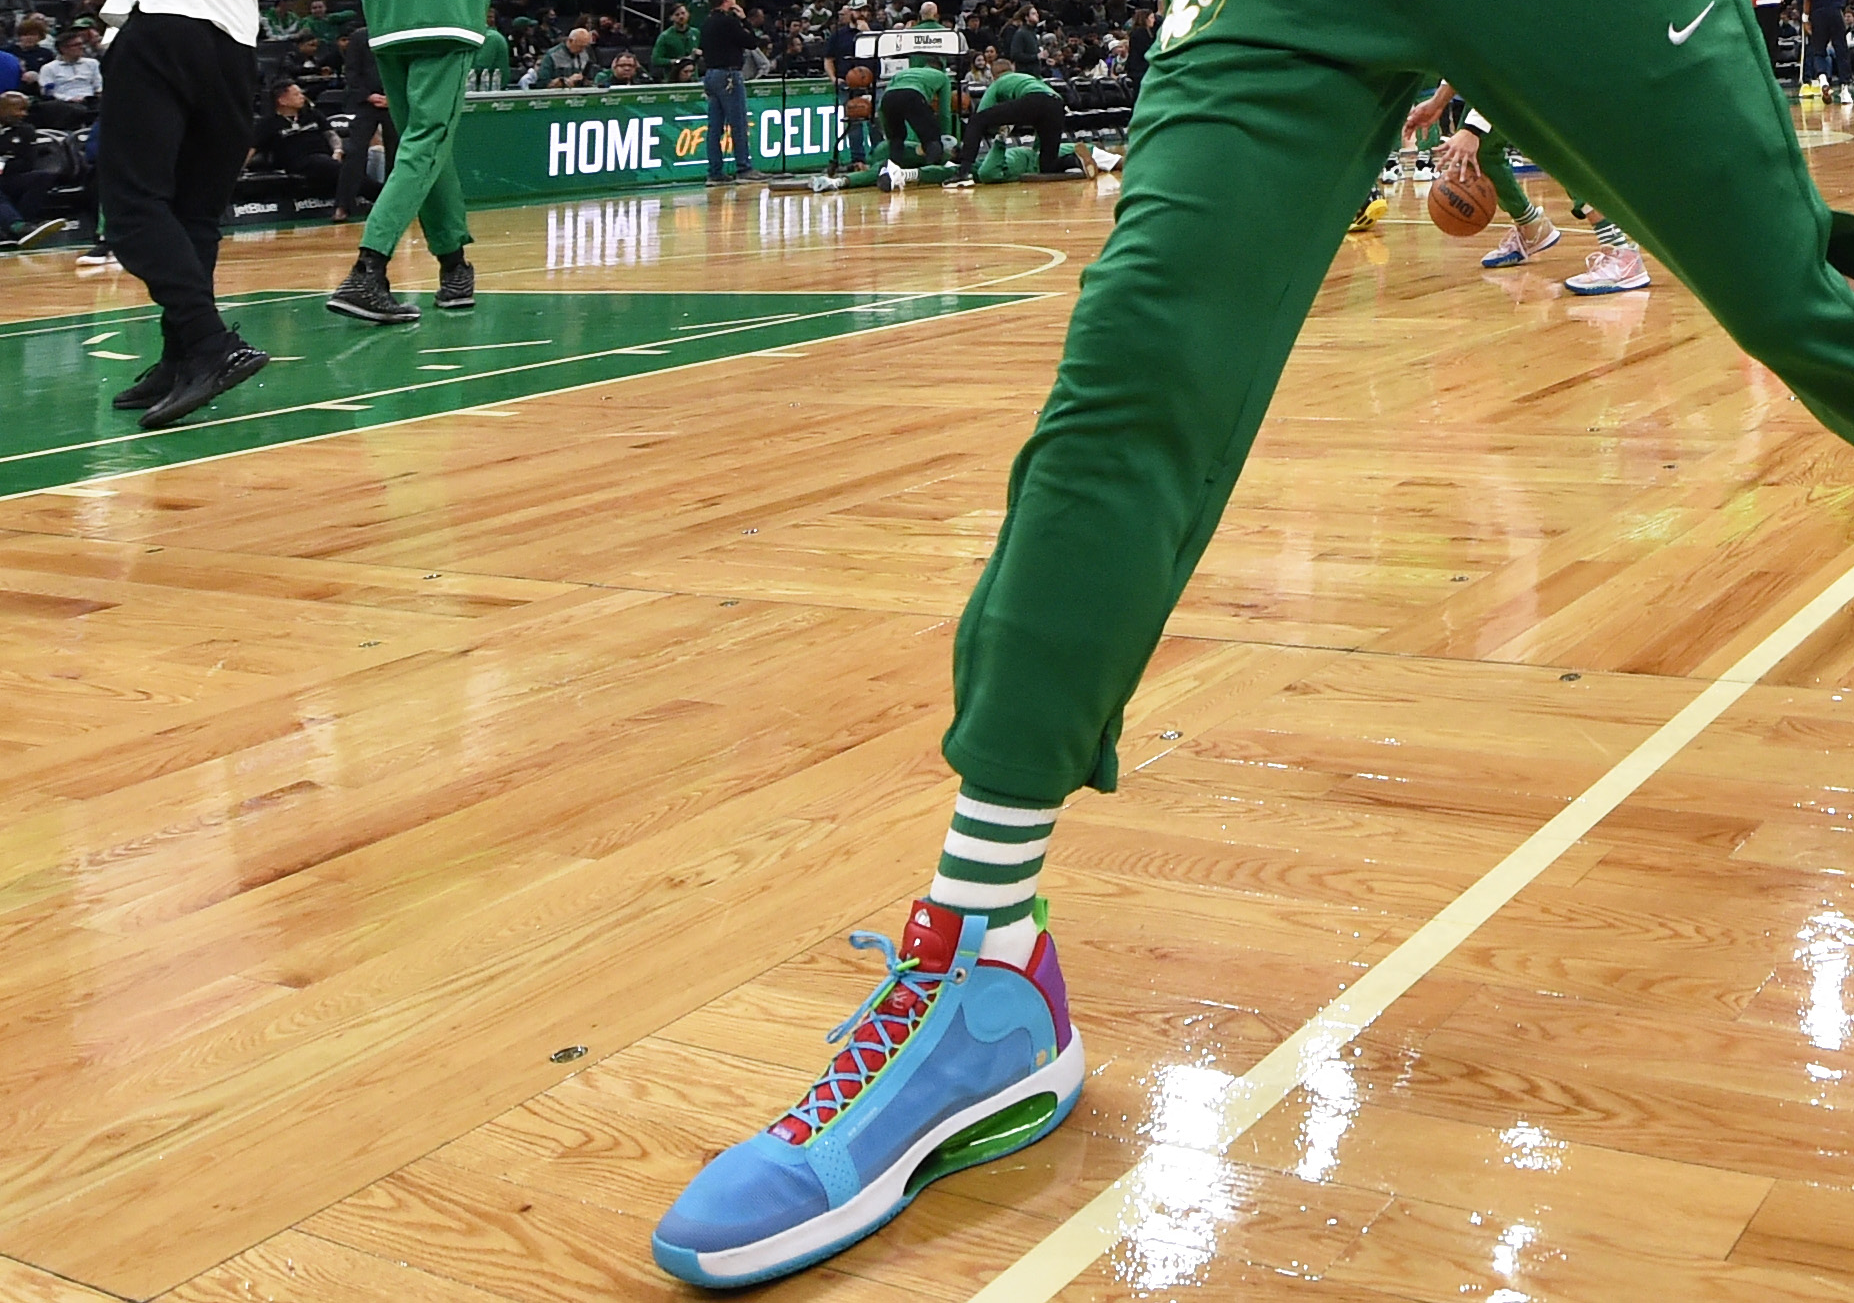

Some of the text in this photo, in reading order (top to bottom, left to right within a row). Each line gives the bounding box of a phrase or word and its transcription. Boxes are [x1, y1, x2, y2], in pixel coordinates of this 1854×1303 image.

[914, 35, 943, 45] Wilson
[548, 117, 663, 176] HOME
[675, 125, 708, 157] OF
[233, 203, 278, 217] jetBlue
[294, 198, 335, 212] jetBlue
